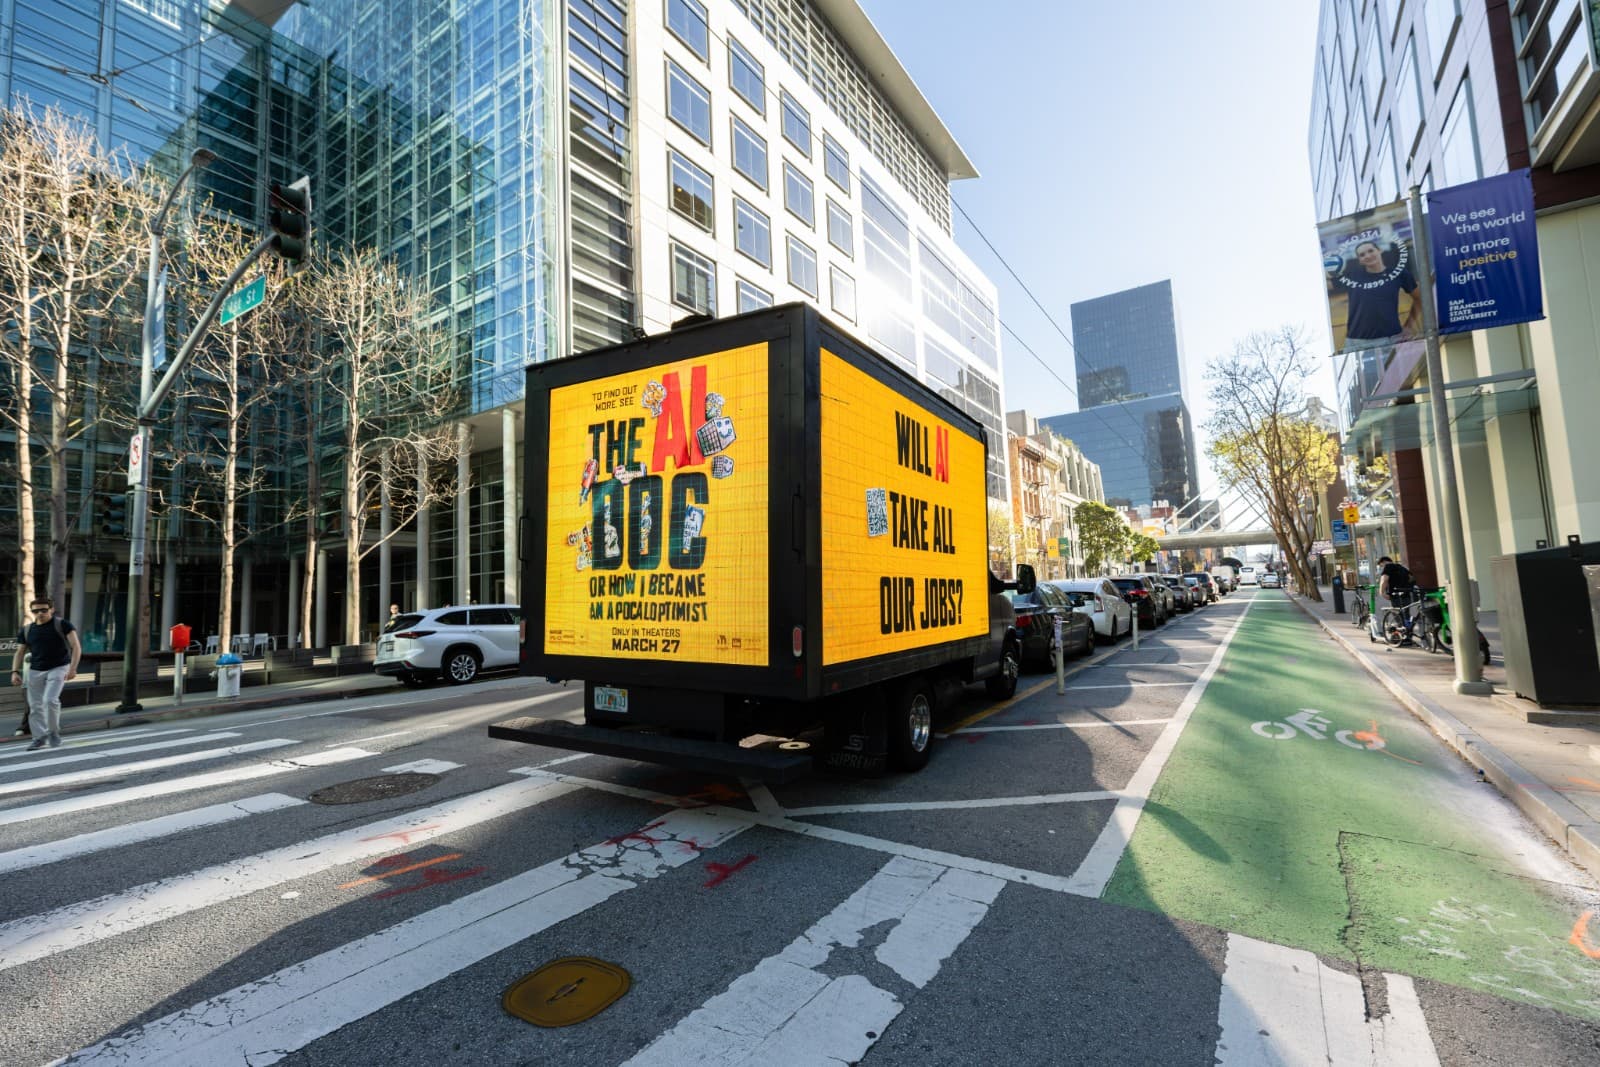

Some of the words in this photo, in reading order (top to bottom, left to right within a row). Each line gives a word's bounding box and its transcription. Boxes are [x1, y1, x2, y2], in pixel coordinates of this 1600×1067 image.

[1441, 213, 1467, 225] We
[1470, 207, 1496, 220] see
[1456, 223, 1480, 234] the
[1483, 210, 1525, 229] world
[1445, 246, 1457, 257] in
[1460, 245, 1470, 253] a
[1473, 237, 1510, 251] more
[1459, 250, 1517, 270] positive
[1451, 270, 1486, 285] light.
[1449, 298, 1464, 306] SAN
[1449, 299, 1495, 311] FRANCISCO
[1449, 309, 1472, 317] STATE
[1450, 310, 1498, 322] UNIVERSITY
[592, 392, 602, 402] TO
[604, 388, 620, 399] FIND
[622, 384, 638, 396] OUT
[619, 396, 635, 407] SEE
[588, 417, 645, 476] THE
[651, 365, 708, 472] AI
[895, 410, 932, 477] WILL
[936, 425, 949, 484] AI
[591, 472, 709, 571] DOC
[889, 491, 929, 551] TAKE
[933, 504, 956, 555] ALL
[590, 575, 605, 597] OR
[609, 573, 636, 597] HOW
[640, 575, 645, 597] I
[648, 573, 706, 598] BECAME
[590, 601, 603, 620] AN
[607, 600, 708, 622] APOCALOPTIMIST
[880, 576, 915, 634] OUR
[920, 578, 963, 629] JOBS?
[612, 627, 630, 636] ONLY
[632, 628, 639, 637] IN
[641, 627, 681, 638] THEATERS
[612, 638, 657, 652] MARCH
[661, 639, 681, 653] 27
